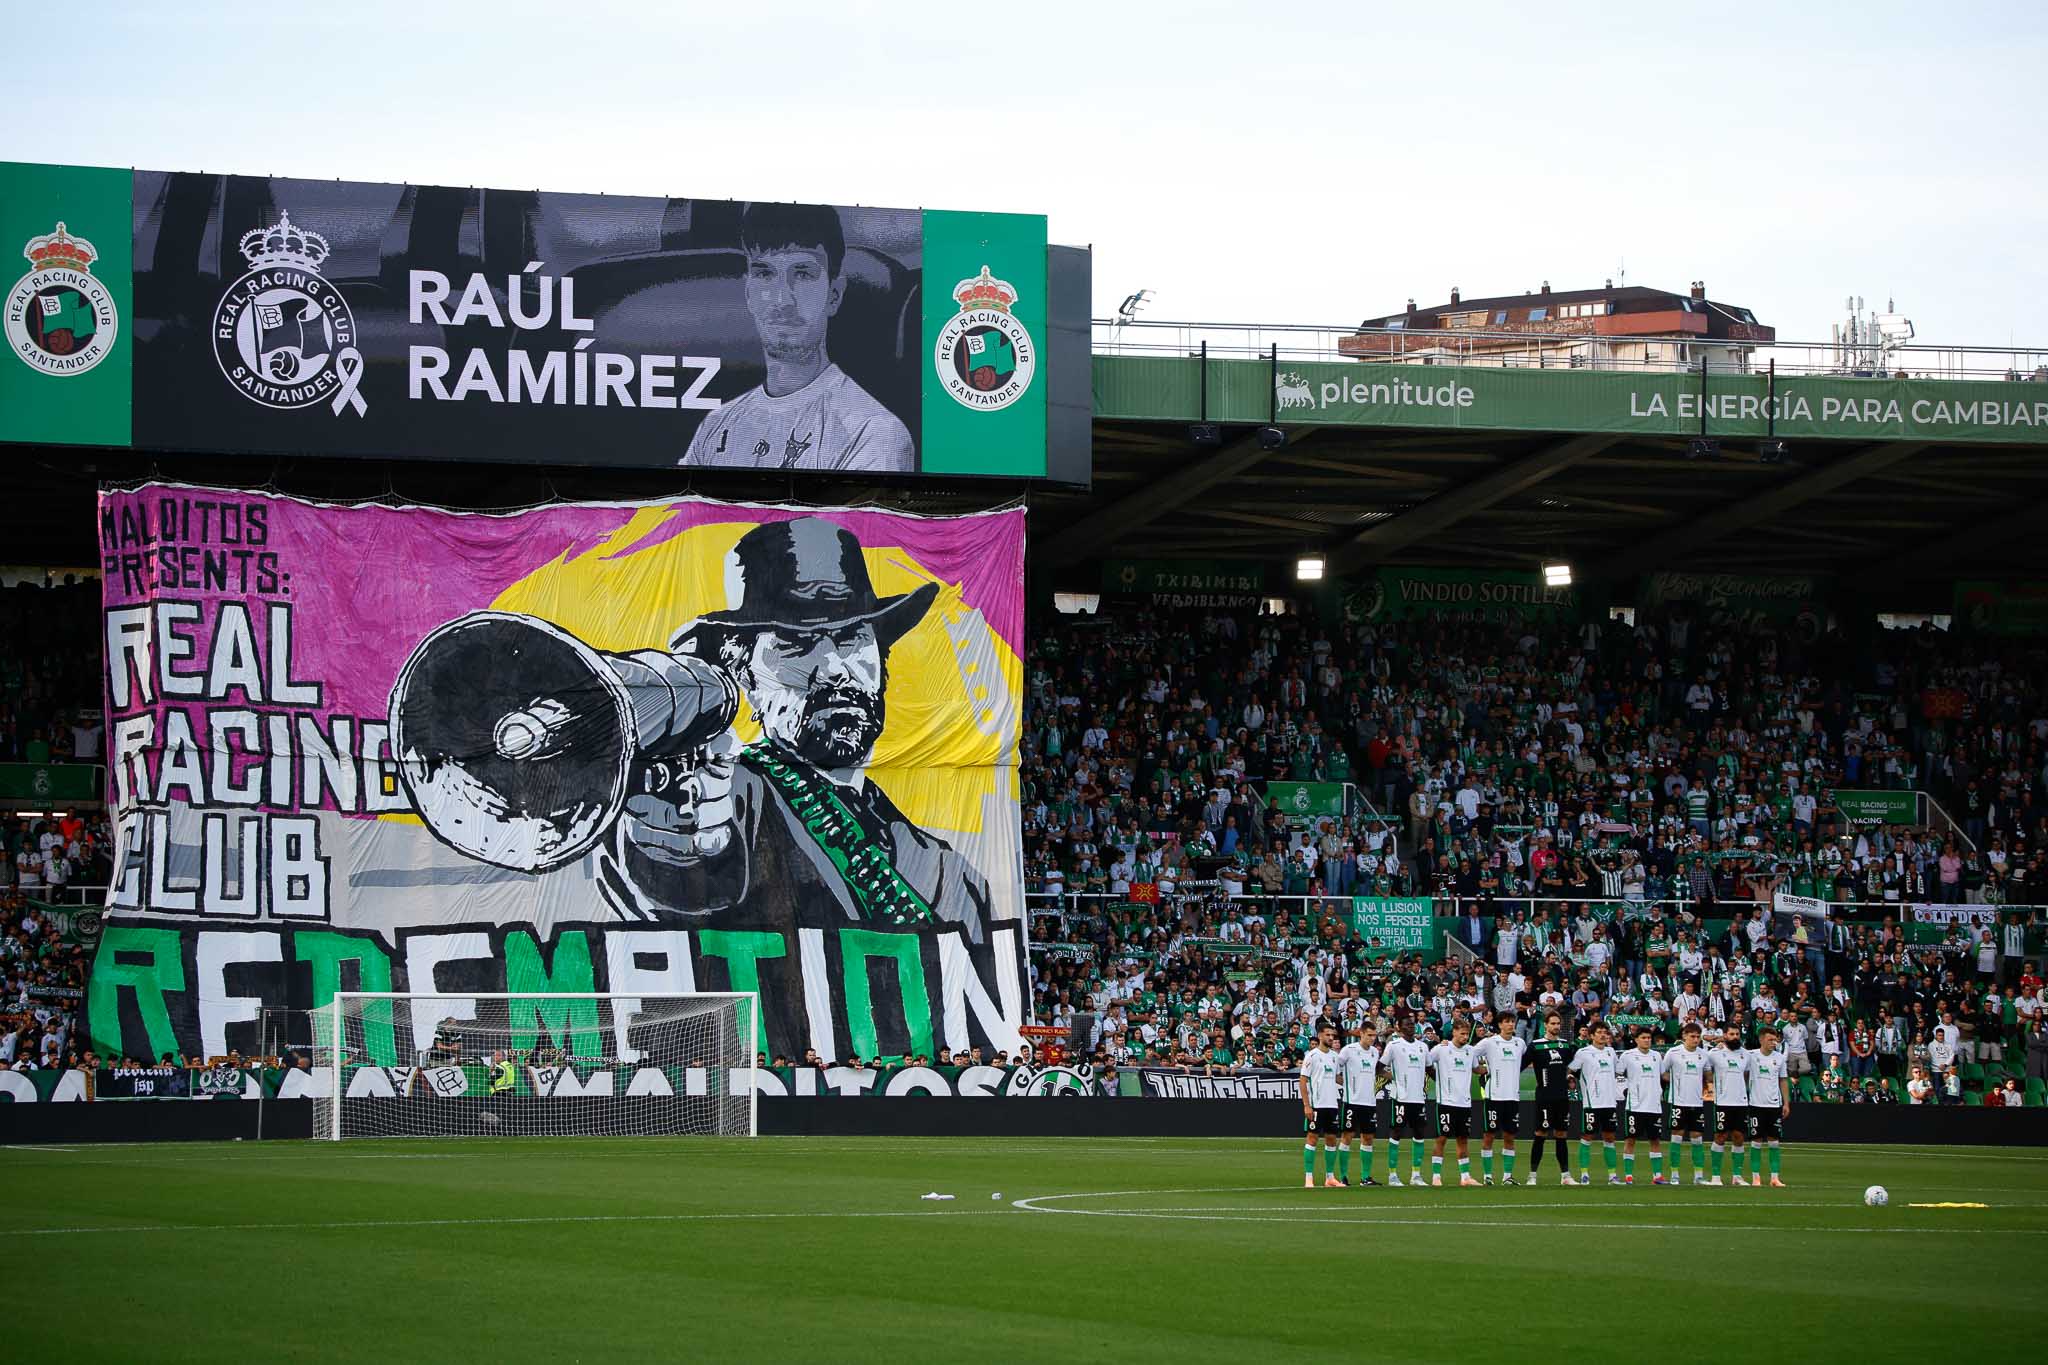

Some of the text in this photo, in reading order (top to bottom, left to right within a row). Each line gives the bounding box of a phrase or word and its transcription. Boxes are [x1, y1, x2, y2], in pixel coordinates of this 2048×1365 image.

[11, 272, 111, 325] REAL RACING CLUB
[219, 272, 350, 343] REAL RACING CLUB
[410, 262, 594, 331] RAÚL
[942, 312, 1029, 363] REAL RACING CLUB
[21, 342, 101, 369] SANTANDER
[232, 366, 337, 402] SANTANDER
[410, 338, 721, 411] RAMÍREZ
[950, 379, 1021, 405] SANTANDER
[1321, 375, 1475, 409] plenitude
[1630, 389, 2048, 427] LA ENERGÍA PARA CAMBIAR
[102, 498, 267, 549] MALDITOS
[104, 547, 291, 596] PRESENTS:
[1400, 579, 1473, 602] VINDIO
[105, 598, 323, 712] REAL
[111, 706, 419, 820] RACING
[1861, 801, 1888, 809] RACING
[105, 808, 331, 924] CLUB
[1357, 902, 1377, 913] UNA
[1783, 896, 1818, 906] SIEMPRE
[1358, 914, 1431, 926] NOS PERSIGUE
[1411, 927, 1422, 936] EN
[1367, 936, 1423, 947] ASTRALIA
[1346, 1109, 1352, 1120] 2
[1395, 1105, 1405, 1116] 14
[1440, 1113, 1450, 1124] 21
[1488, 1110, 1497, 1121] 16
[1542, 1109, 1548, 1119] 1
[1585, 1112, 1595, 1123] 15
[1628, 1115, 1635, 1126] 8
[1716, 1111, 1725, 1122] 12
